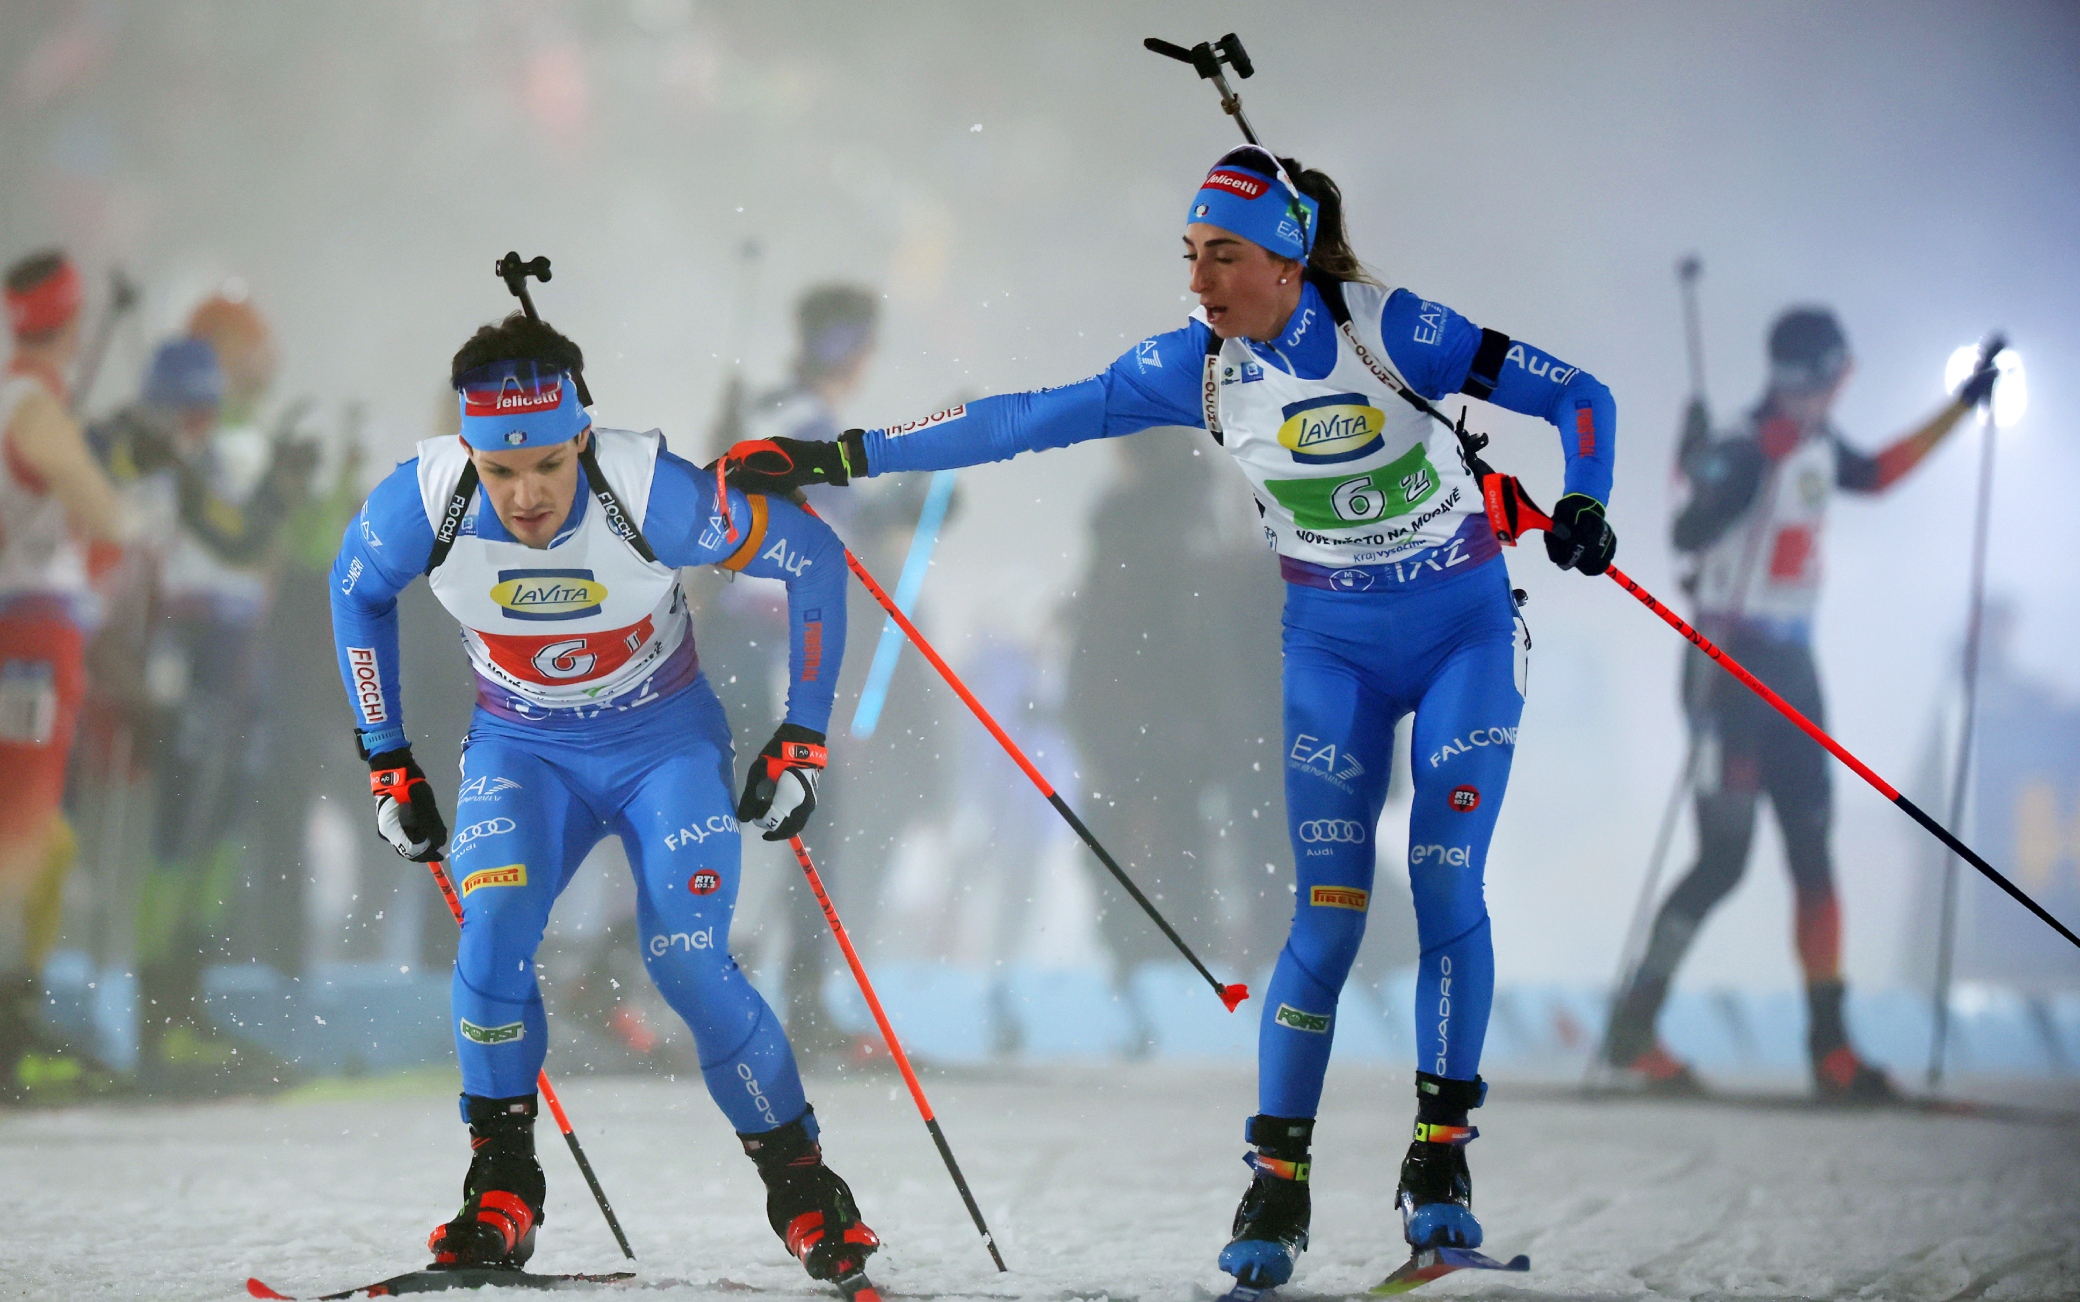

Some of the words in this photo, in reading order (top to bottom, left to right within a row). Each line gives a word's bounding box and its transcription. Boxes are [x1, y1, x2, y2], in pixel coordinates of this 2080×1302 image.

[1206, 174, 1258, 196] felicetti
[1342, 324, 1397, 390] FIOCCHI
[496, 391, 558, 410] felicetti
[1205, 357, 1216, 430] FIOCCHI
[885, 405, 964, 437] FIOCCHI
[1330, 475, 1386, 521] 6
[1400, 469, 1431, 504] 2
[438, 494, 466, 543] FIOCCHI
[597, 491, 637, 541] FIOCCHI
[531, 639, 597, 679] 6
[351, 650, 384, 722] FIOCCHI
[1290, 733, 1365, 780] EA7
[1455, 791, 1475, 801] RTL
[1306, 848, 1333, 857] Audi
[1411, 844, 1471, 868] enel
[464, 869, 519, 893] PIRELLI
[696, 875, 716, 884] RTL
[1314, 890, 1365, 908] PIRELLI
[650, 926, 713, 956] enel
[462, 1022, 523, 1043] FORST
